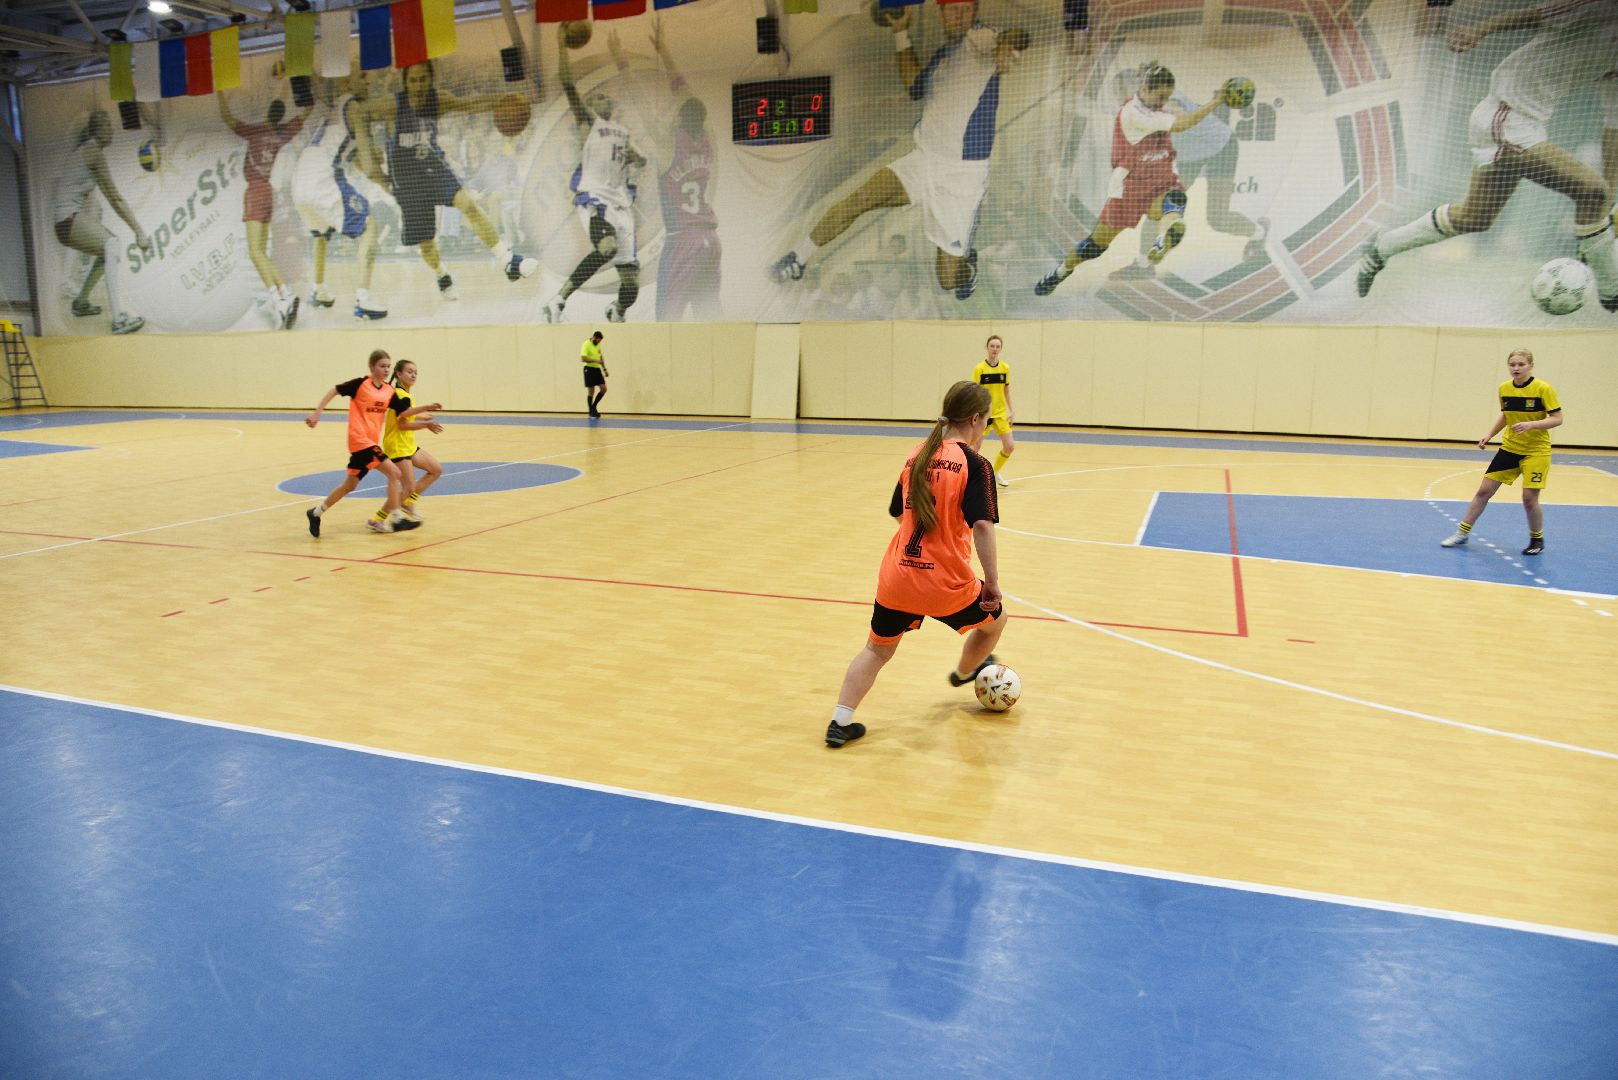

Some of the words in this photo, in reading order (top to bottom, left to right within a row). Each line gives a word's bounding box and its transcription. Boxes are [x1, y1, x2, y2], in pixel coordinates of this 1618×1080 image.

[757, 99, 768, 116] 2
[775, 99, 785, 115] 2
[811, 95, 822, 112] 0
[748, 122, 759, 138] 0
[803, 118, 814, 133] 0
[1531, 472, 1542, 483] 23
